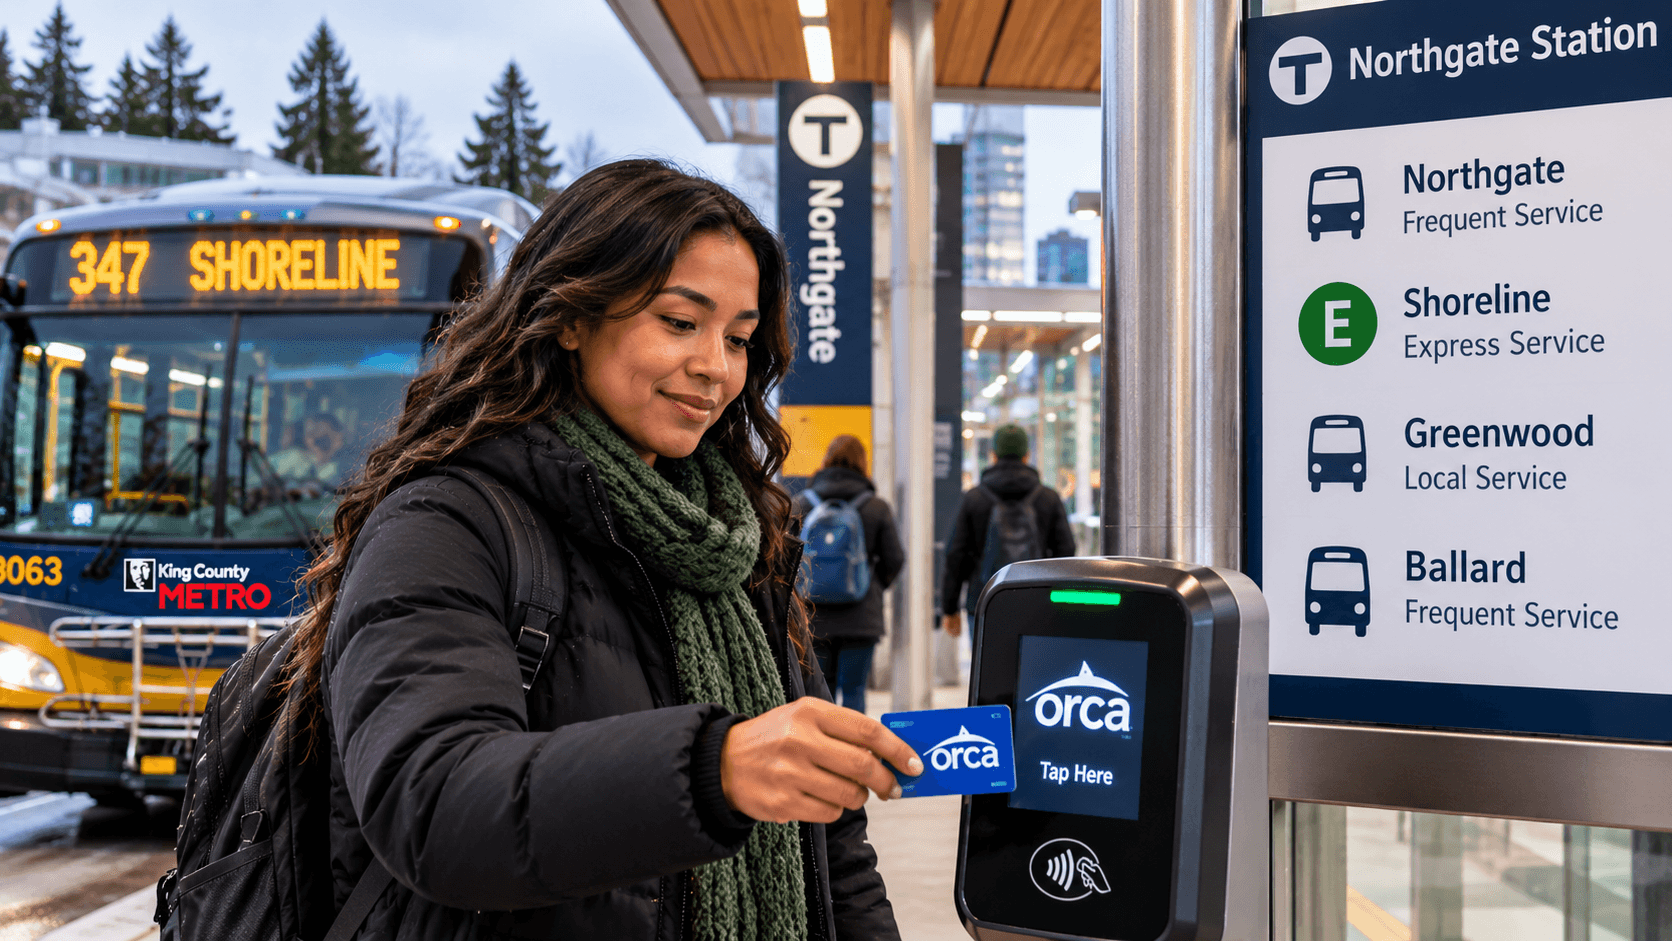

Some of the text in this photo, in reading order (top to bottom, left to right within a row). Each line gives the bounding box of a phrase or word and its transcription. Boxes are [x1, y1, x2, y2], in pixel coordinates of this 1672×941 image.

[1349, 16, 1658, 79] Northgate Station
[1278, 51, 1323, 96] T
[804, 114, 848, 156] T
[1403, 156, 1565, 196] Northgate
[1403, 198, 1603, 238] Frequent Service
[69, 238, 401, 295] 347 SHORELINE
[800, 179, 845, 364] Northgate
[1403, 283, 1551, 319] Shoreline
[1324, 299, 1352, 348] E
[1404, 328, 1605, 366] Express Service
[1404, 414, 1594, 448] Greenwood
[1405, 464, 1567, 490] Local Service
[158, 562, 250, 582] King County
[1406, 549, 1526, 584] Ballard
[158, 582, 272, 610] METRO
[1406, 599, 1619, 632] Frequent Service
[1034, 692, 1131, 732] orca
[930, 745, 1000, 771] orca
[1040, 761, 1114, 786] Tap Here
